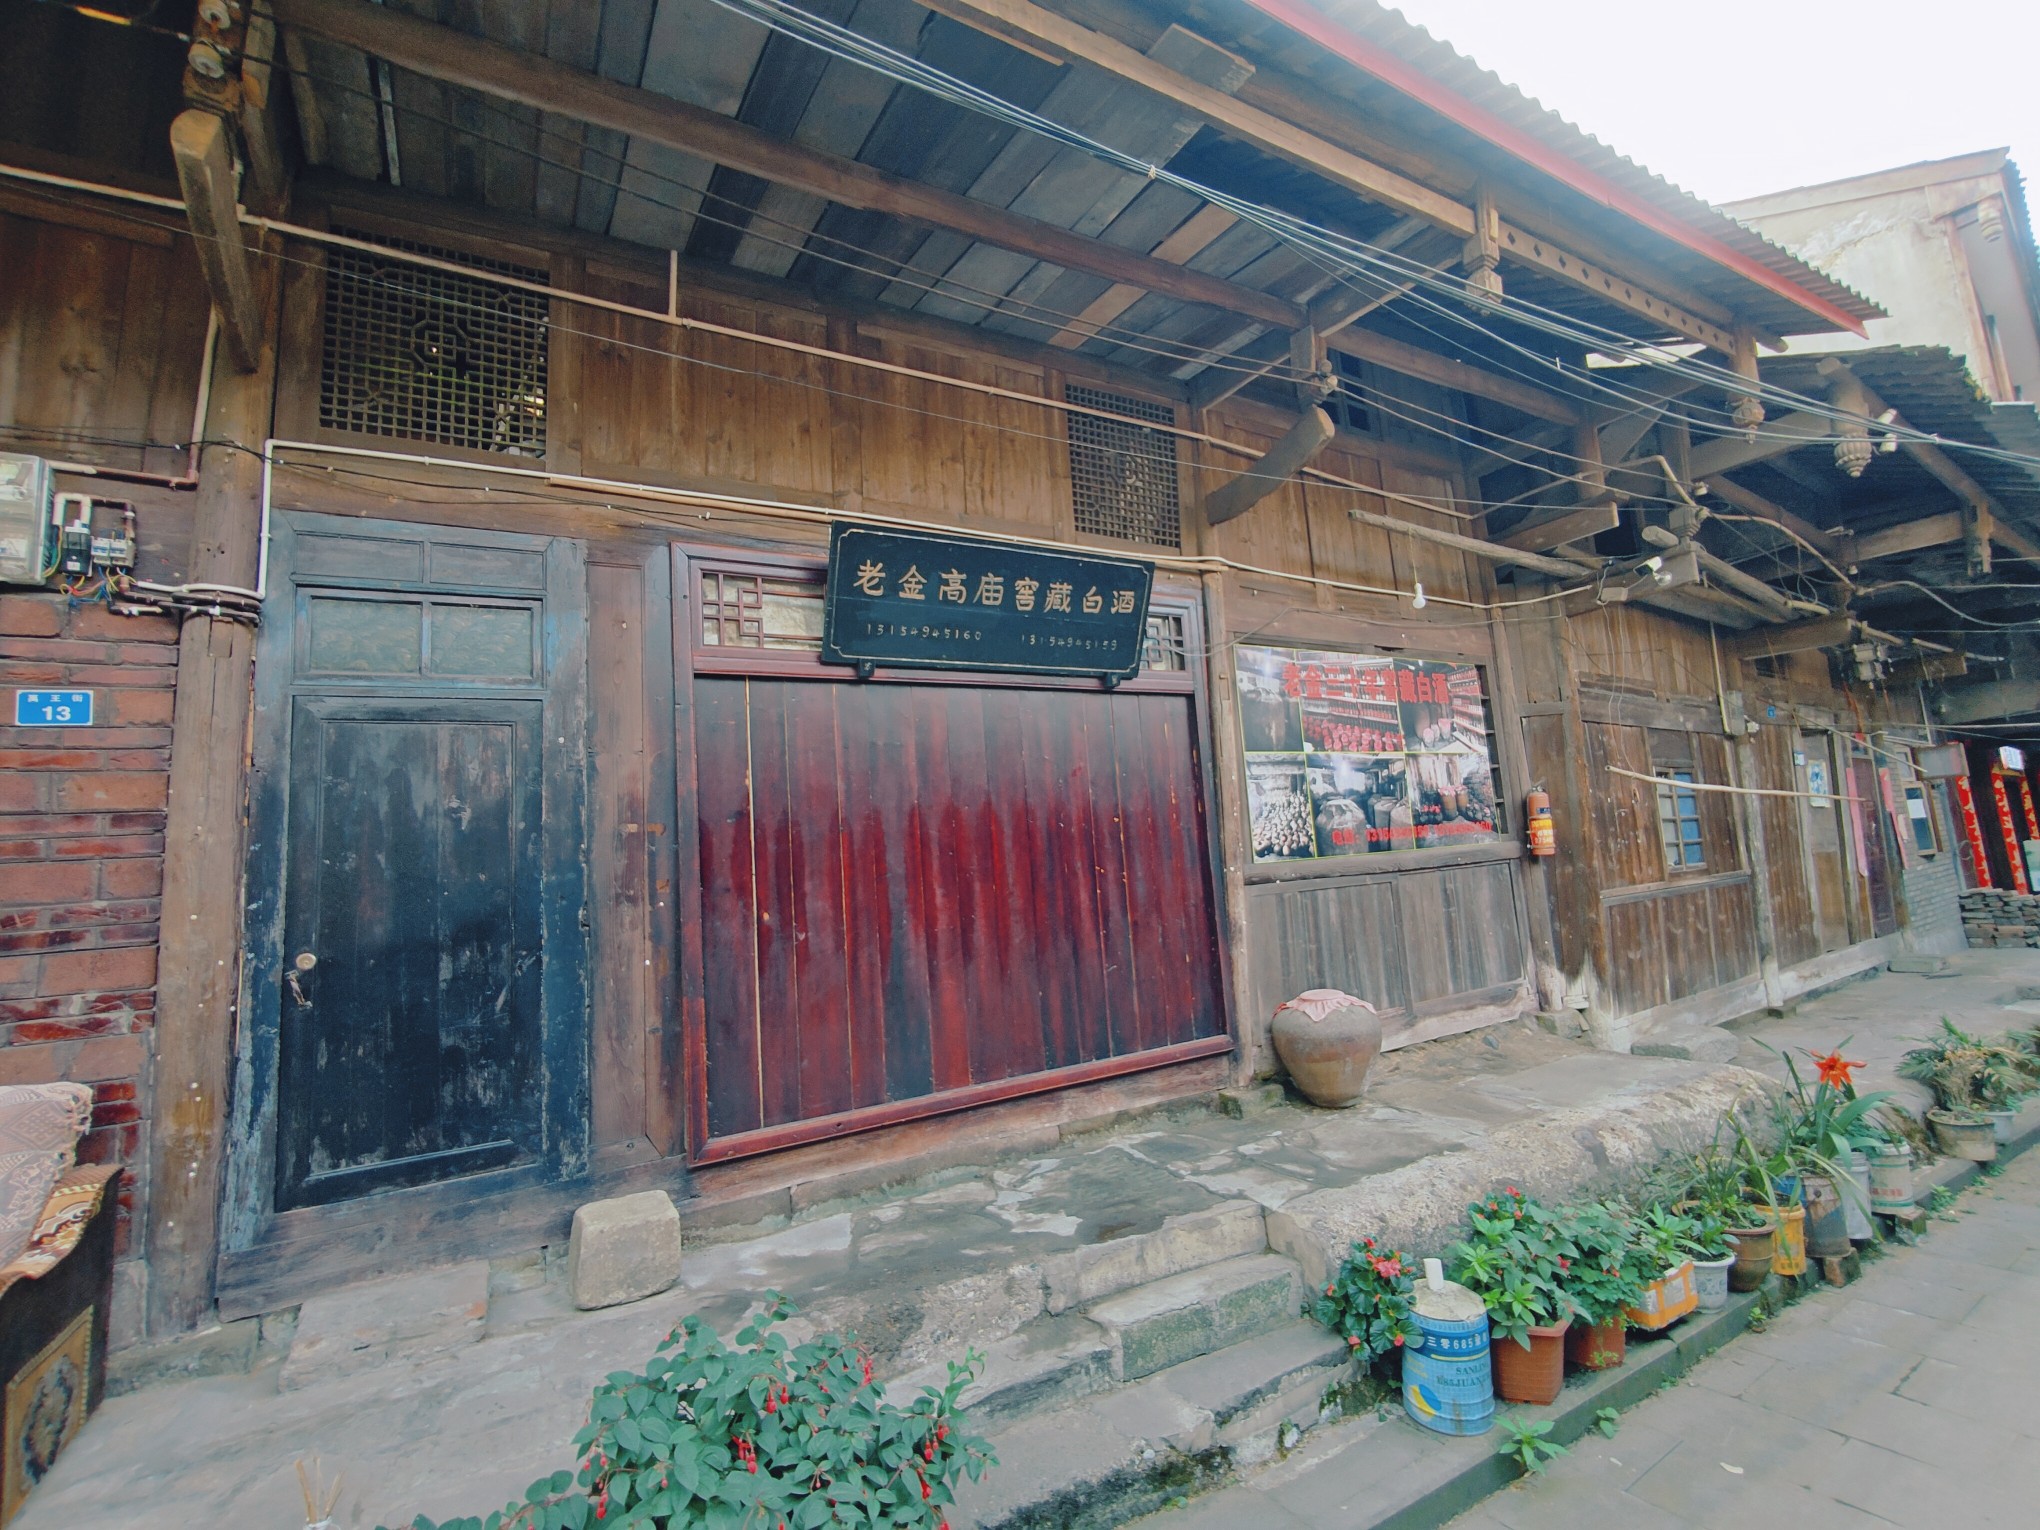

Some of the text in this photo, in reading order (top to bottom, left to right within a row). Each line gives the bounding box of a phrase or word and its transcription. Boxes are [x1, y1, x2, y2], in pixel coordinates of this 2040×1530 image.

[853, 559, 1135, 615] 老金高庙窖藏白酒
[866, 623, 982, 641] 13154945160
[41, 705, 71, 721] 13
